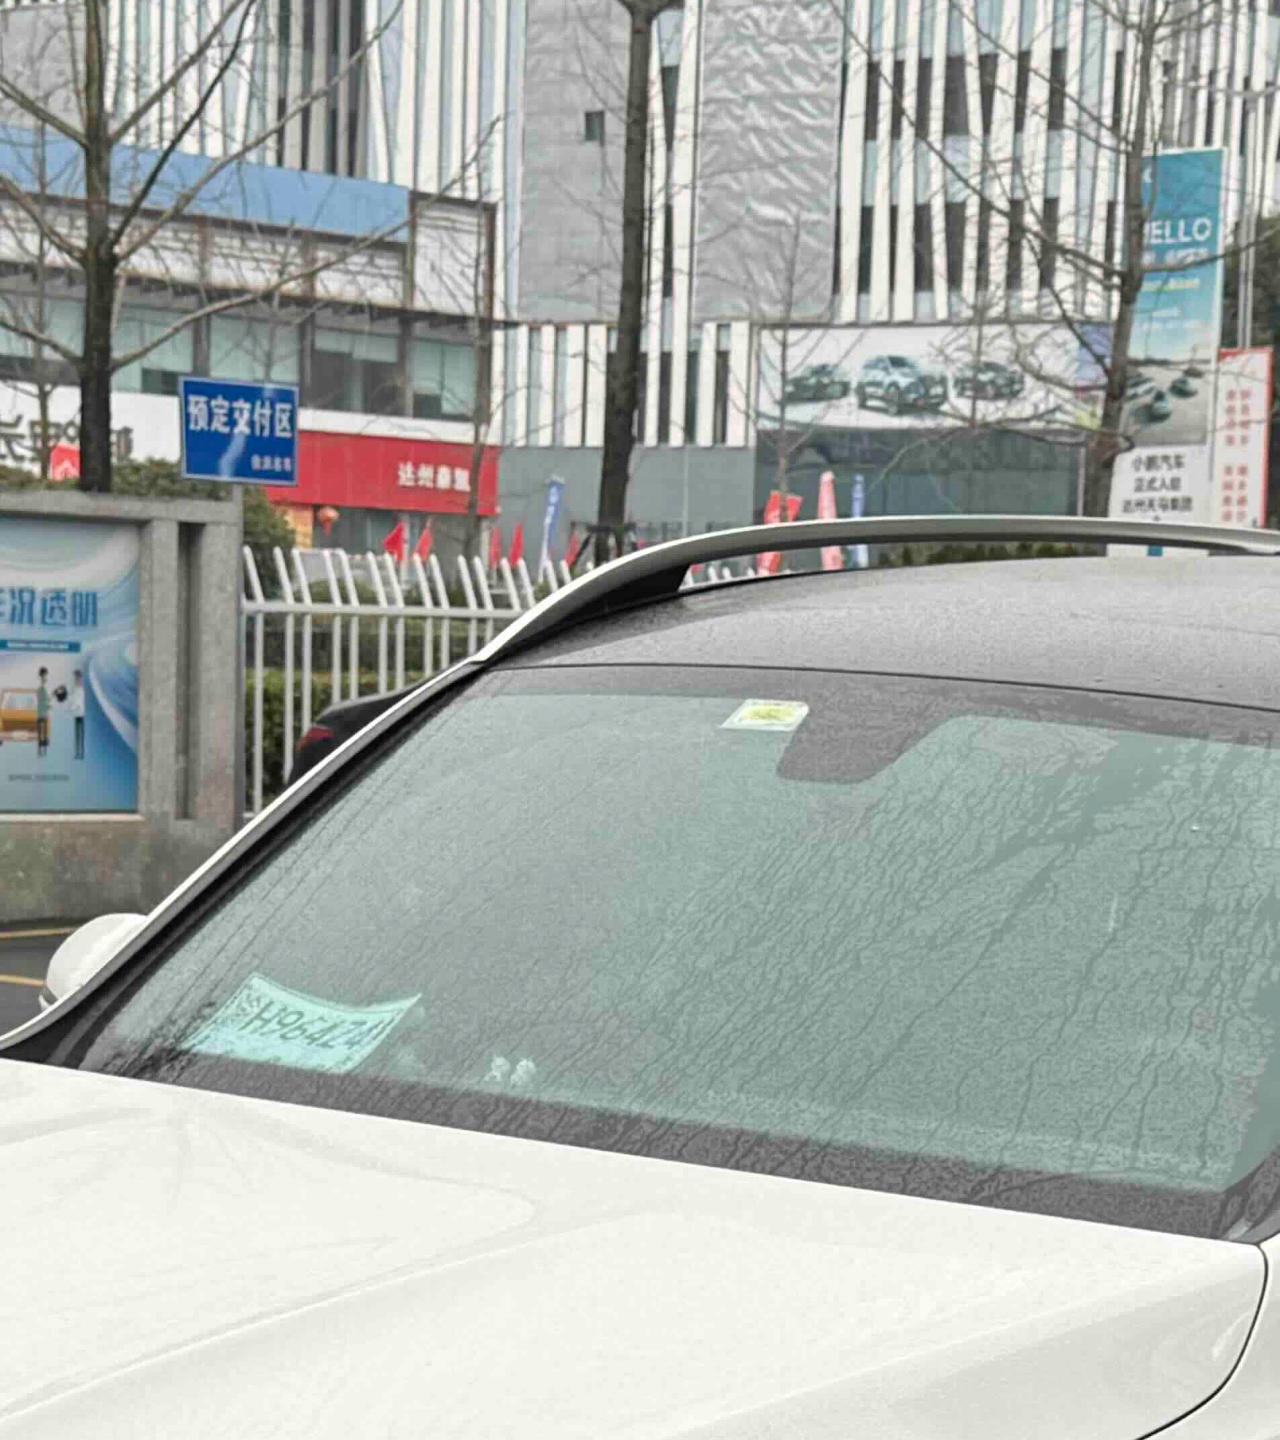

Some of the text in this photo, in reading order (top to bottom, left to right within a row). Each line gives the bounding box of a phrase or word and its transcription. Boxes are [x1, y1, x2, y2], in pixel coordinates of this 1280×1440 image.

[1143, 217, 1213, 244] ELLO
[187, 394, 292, 438] 预定交付区
